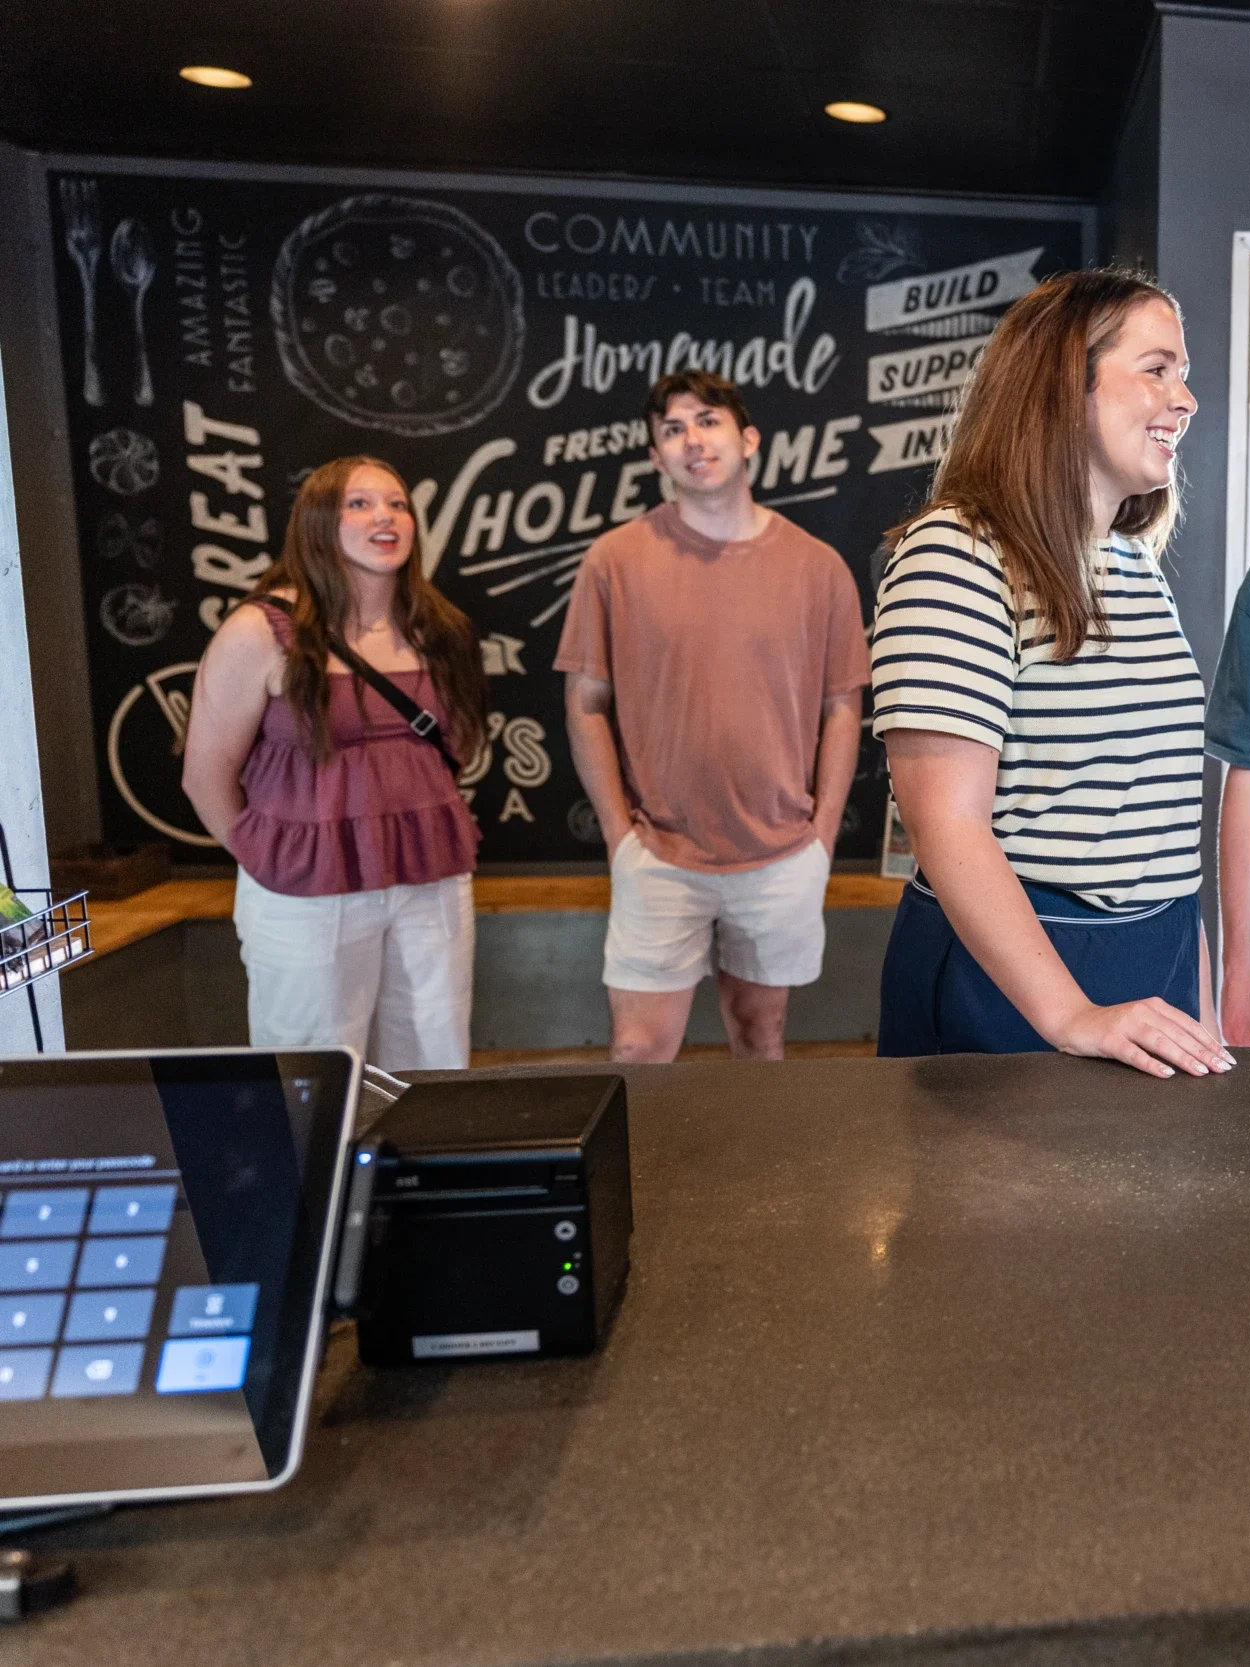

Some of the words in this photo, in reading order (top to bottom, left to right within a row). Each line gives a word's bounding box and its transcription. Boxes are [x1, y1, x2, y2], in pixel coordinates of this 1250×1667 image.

[524, 210, 820, 263] COMMUNITY
[170, 206, 214, 368] AMAZING
[217, 231, 258, 394] FANTASTIC
[536, 270, 658, 302] LEADERS
[699, 275, 776, 306] TEAM
[903, 268, 999, 315] BUILD
[526, 275, 842, 410] Homemade
[543, 417, 650, 467] FRESH
[409, 415, 862, 581] WHOLEME
